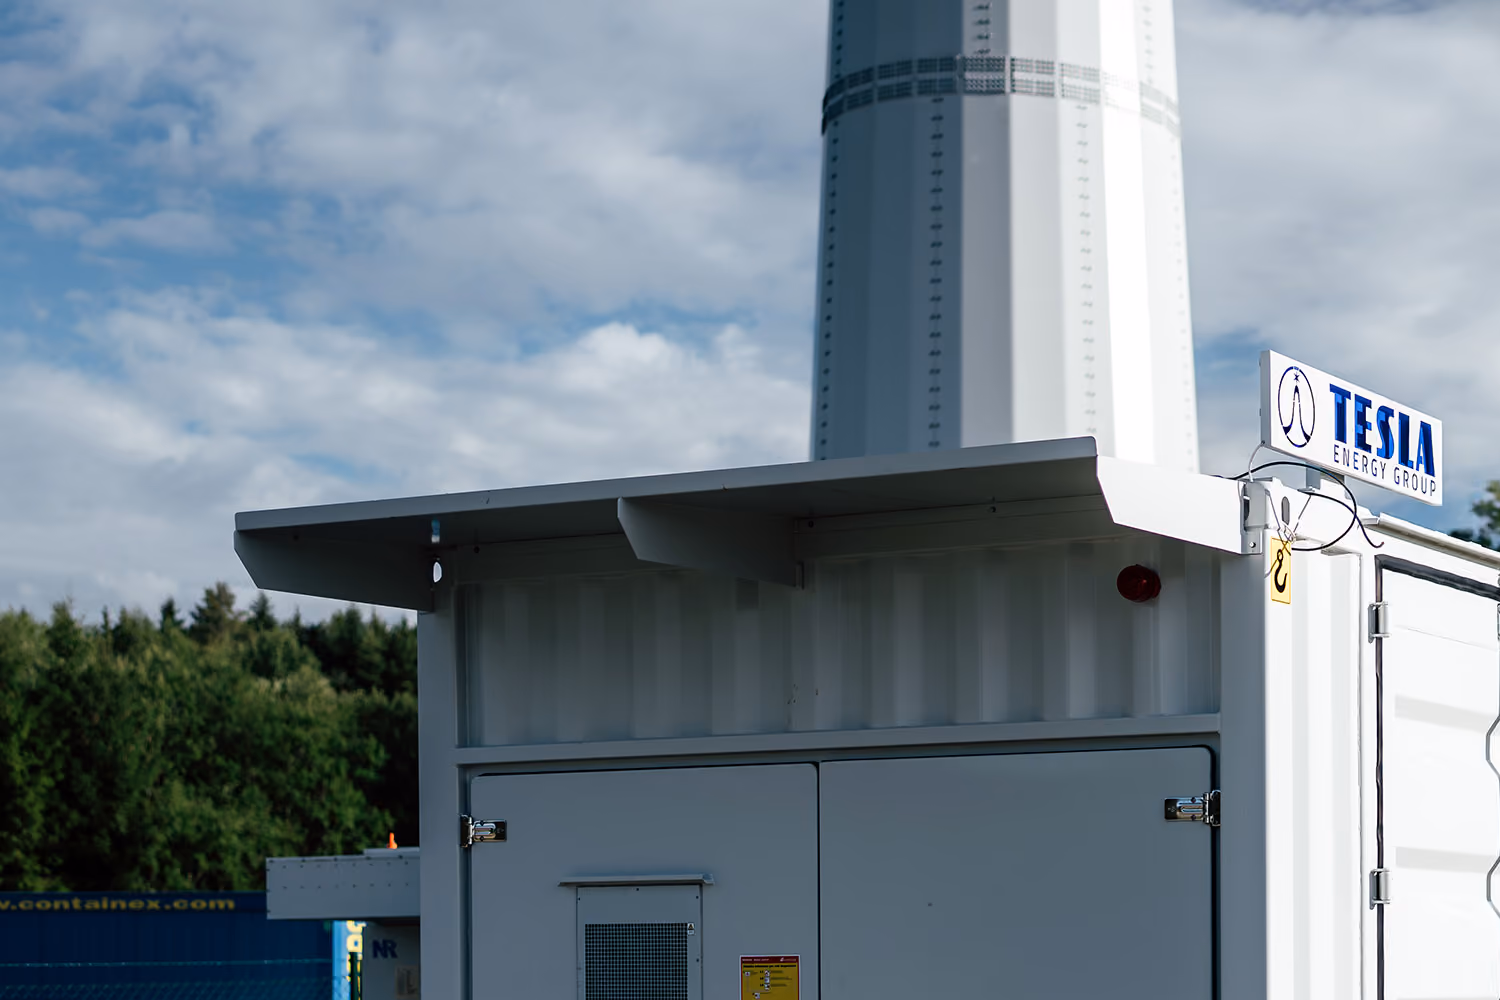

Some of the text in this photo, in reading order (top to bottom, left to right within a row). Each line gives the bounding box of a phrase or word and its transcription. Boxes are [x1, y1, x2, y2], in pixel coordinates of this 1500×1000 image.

[1329, 383, 1436, 477] TESLA
[1333, 444, 1437, 497] ENERGY GROUP
